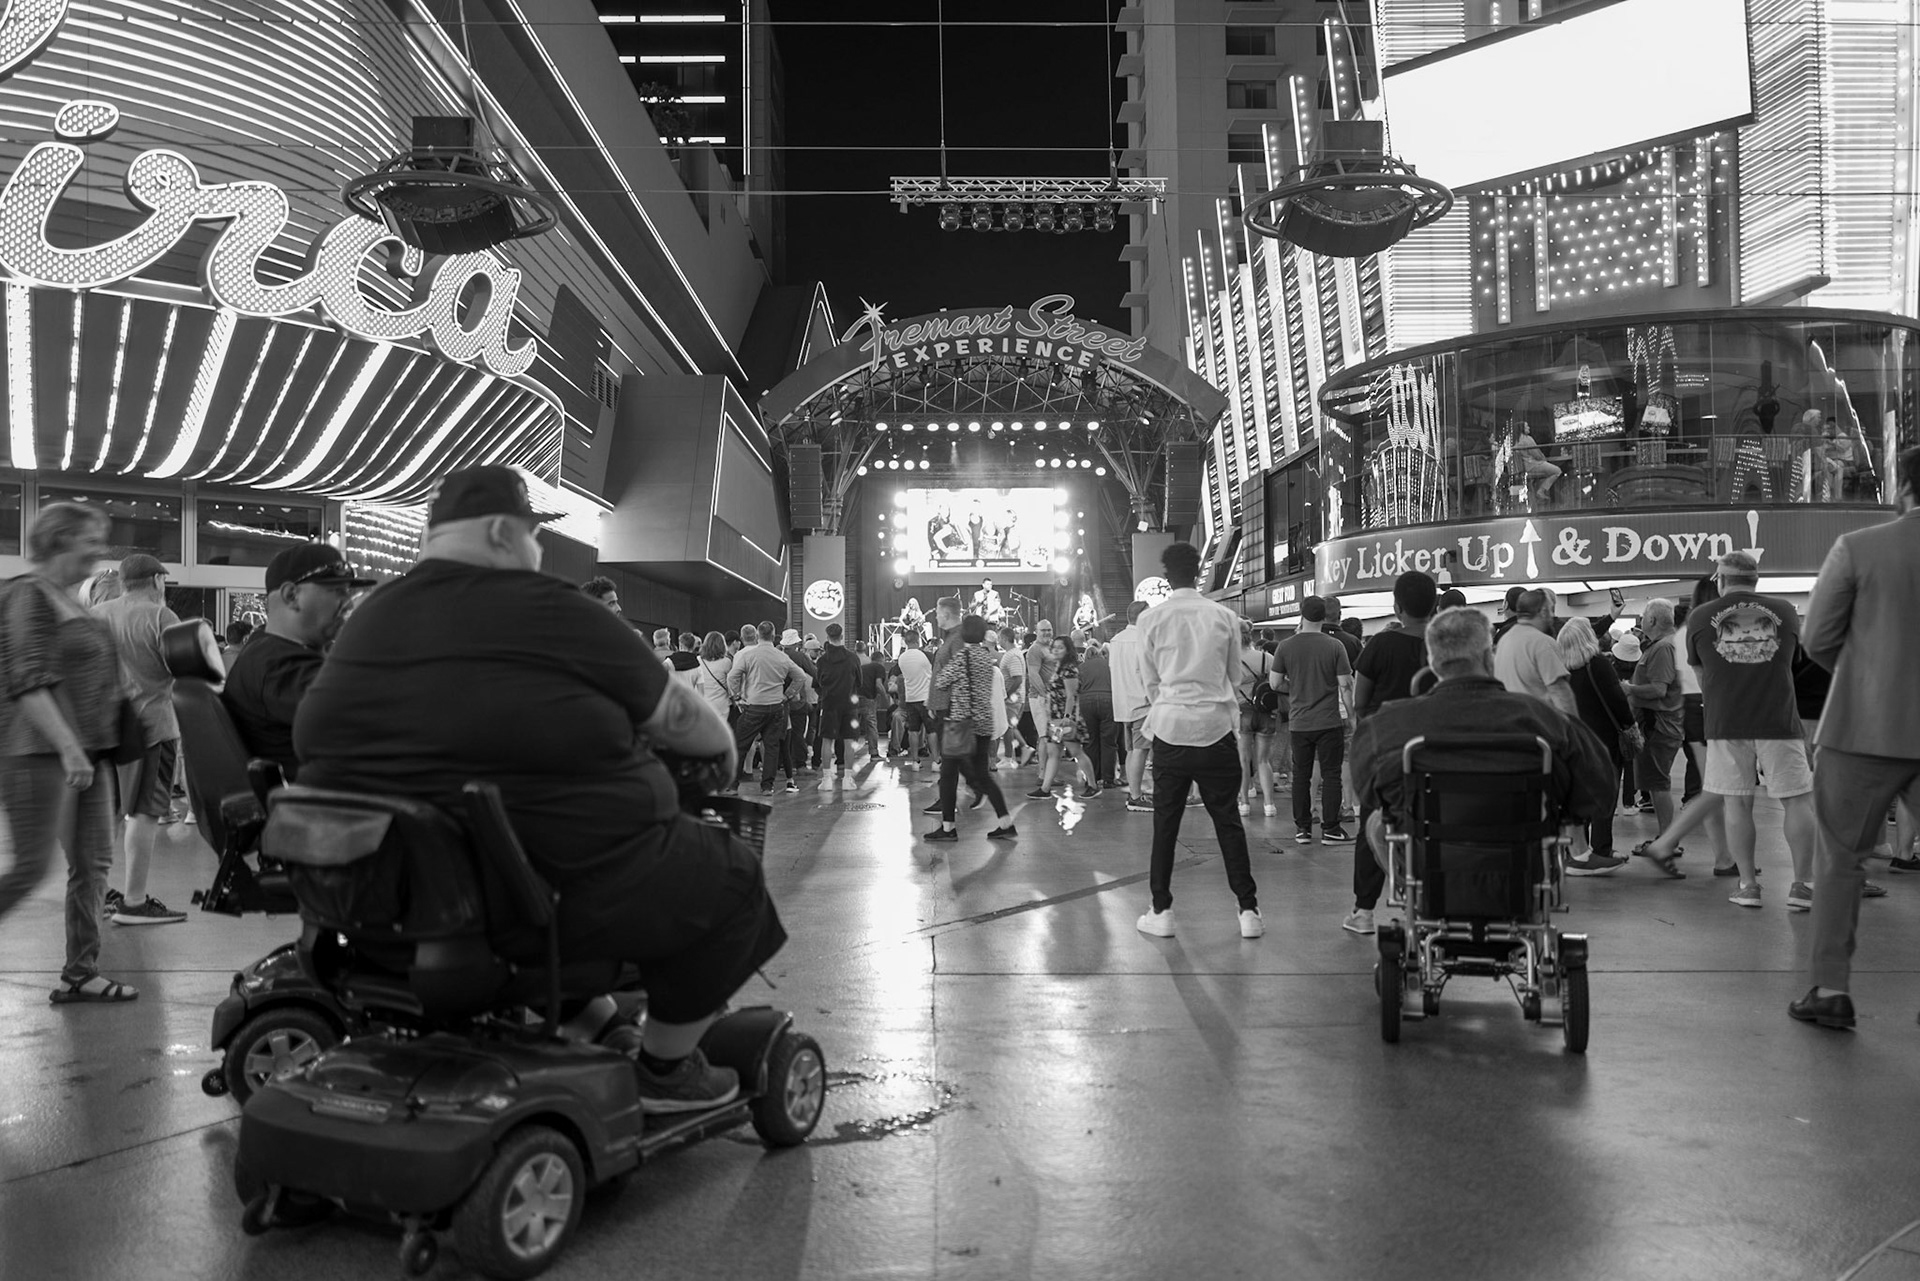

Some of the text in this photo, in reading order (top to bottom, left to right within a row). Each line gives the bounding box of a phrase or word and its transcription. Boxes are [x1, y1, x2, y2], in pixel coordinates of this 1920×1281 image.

[0, 0, 537, 376] irca
[841, 293, 1148, 373] Fremont Street
[892, 337, 1094, 369] EXPERIENCE
[1356, 538, 1448, 579] Licker
[1457, 535, 1515, 578] Up
[1551, 526, 1593, 566] &
[1601, 526, 1735, 563] Down
